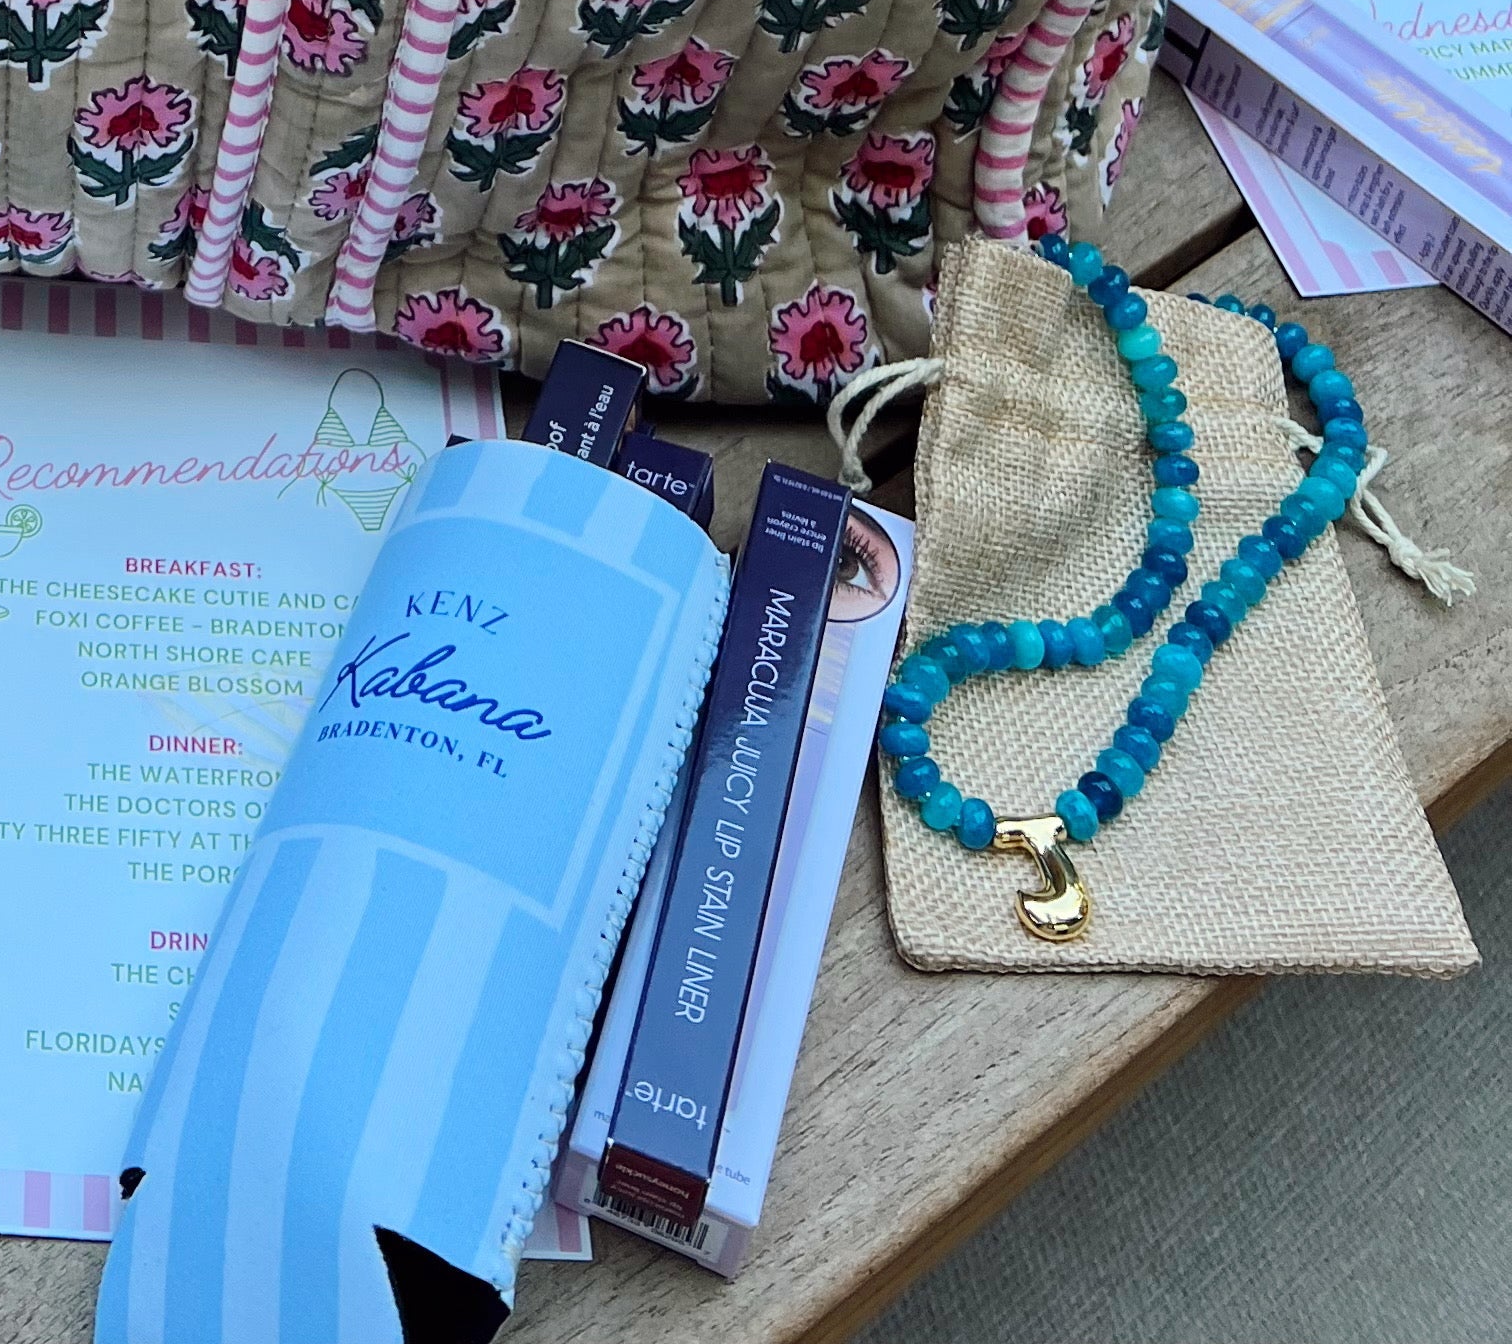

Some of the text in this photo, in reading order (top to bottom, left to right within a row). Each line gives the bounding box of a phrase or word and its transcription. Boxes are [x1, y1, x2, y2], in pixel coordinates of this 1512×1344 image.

[575, 432, 597, 462] ant
[125, 556, 263, 580] BREAKFAST:
[45, 579, 197, 606] CHEESECAKE
[202, 588, 271, 609] CUTIE
[277, 592, 327, 611] AND
[35, 610, 89, 631] FOXI
[95, 612, 186, 634] COFFEE
[405, 590, 510, 635] KENZ
[78, 641, 312, 668] NORTH SHORE CAFE
[80, 670, 304, 698] ORANGE BLOSSOM
[318, 632, 552, 740] Kabana
[148, 734, 245, 757] DINNER:
[316, 720, 508, 779] BRADENTON, FL
[87, 762, 133, 784] THE
[64, 792, 269, 820] THE DOCTORS O
[674, 588, 796, 1025] MARACUJA JUICY LIP STAIN LINER
[33, 822, 110, 847] THREE
[116, 826, 182, 850] FIFTY
[190, 831, 222, 851] AT
[127, 860, 174, 884] THE
[150, 930, 209, 952] DRIN
[110, 962, 159, 986] THE
[107, 1069, 146, 1093] NA
[724, 1166, 751, 1186] tube
